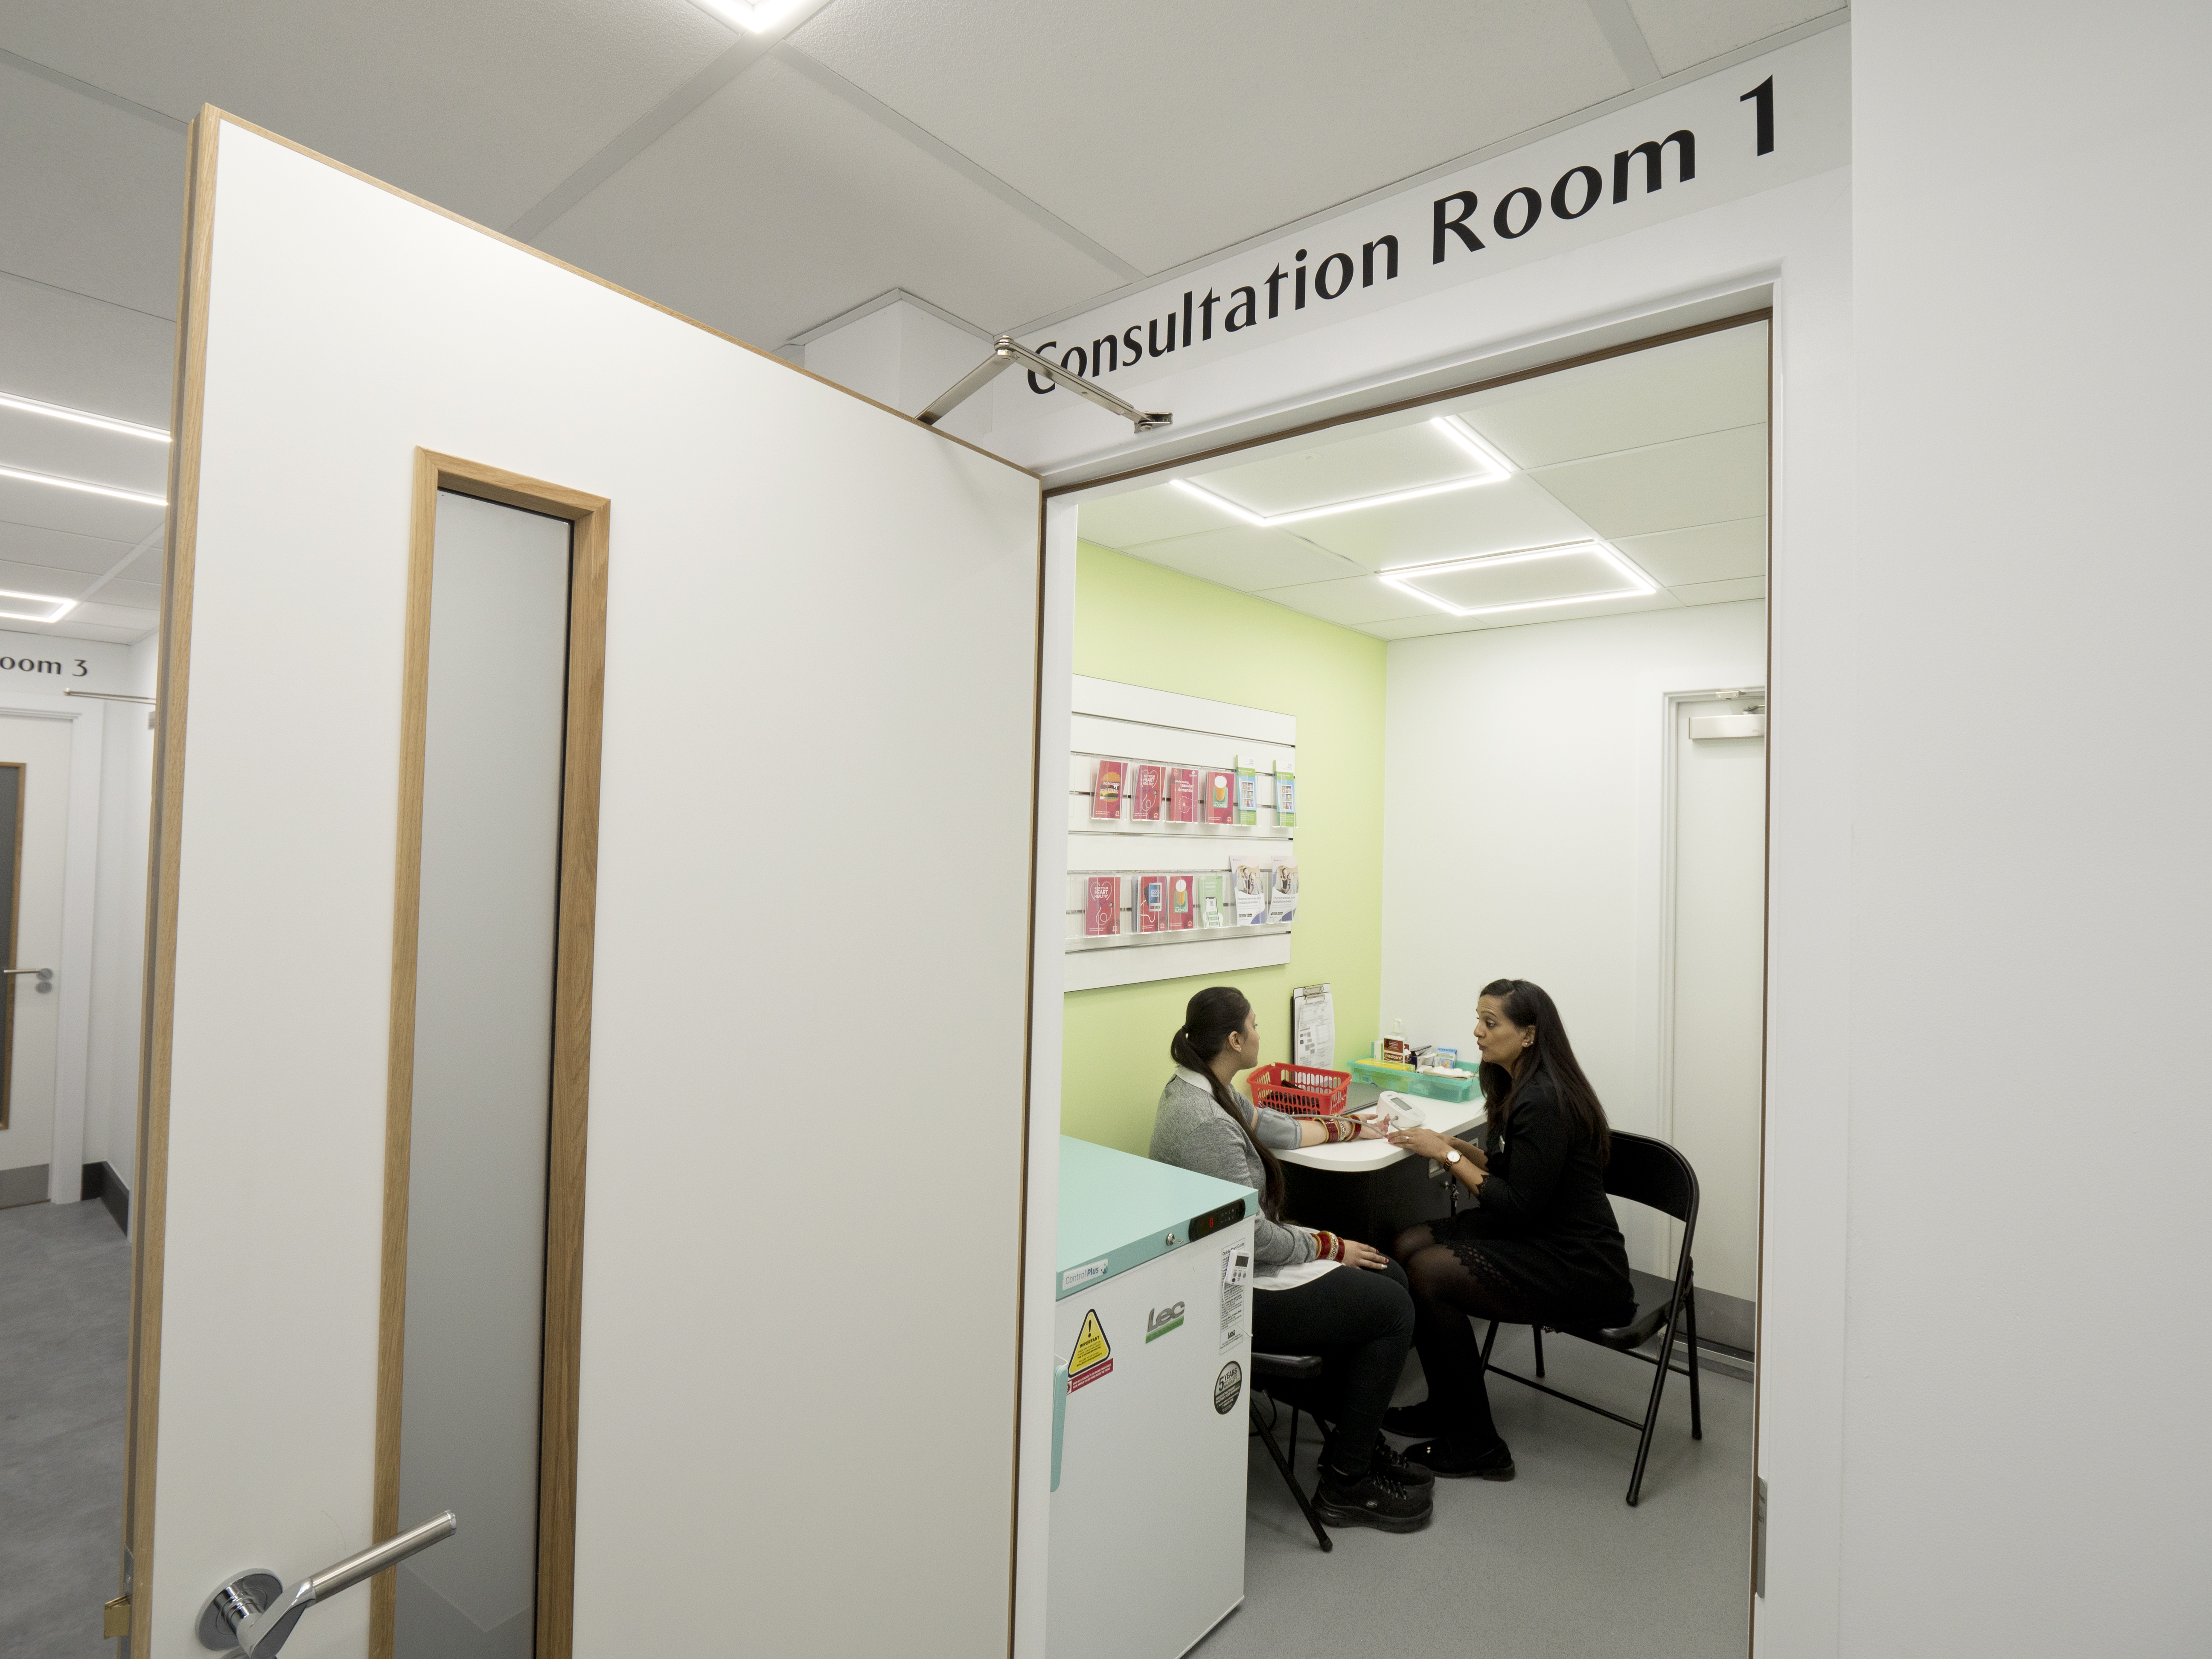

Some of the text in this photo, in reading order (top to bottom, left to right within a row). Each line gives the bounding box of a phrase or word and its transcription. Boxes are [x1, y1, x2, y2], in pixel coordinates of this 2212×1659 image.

[1027, 75, 1773, 394] Consultation Room 1
[72, 660, 87, 676] 3
[1147, 1301, 1185, 1333] Lec
[1080, 1336, 1100, 1348] IMPORTANT
[1219, 1368, 1237, 1391] 5 YEARS
